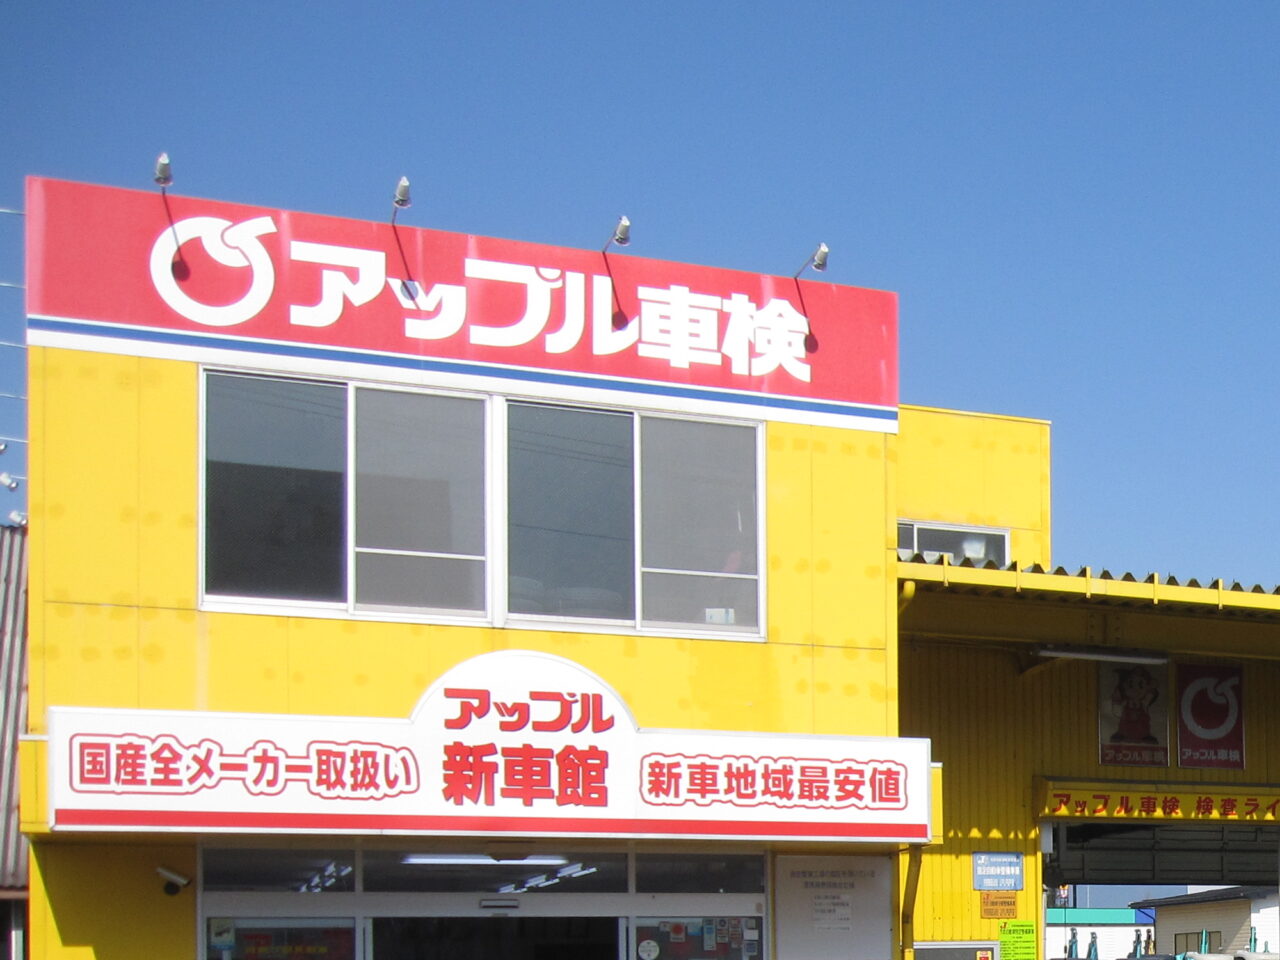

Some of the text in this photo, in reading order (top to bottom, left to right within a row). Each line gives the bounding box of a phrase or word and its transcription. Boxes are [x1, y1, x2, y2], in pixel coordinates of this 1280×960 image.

[289, 240, 812, 383] アップル車検
[443, 687, 615, 735] アップル
[78, 740, 413, 793] 国産全メーカー取扱い
[441, 740, 609, 808] 新車館
[1181, 747, 1241, 763] アップル車検
[646, 759, 904, 805] 新車地域最安値
[1051, 793, 1181, 816] アップル車検
